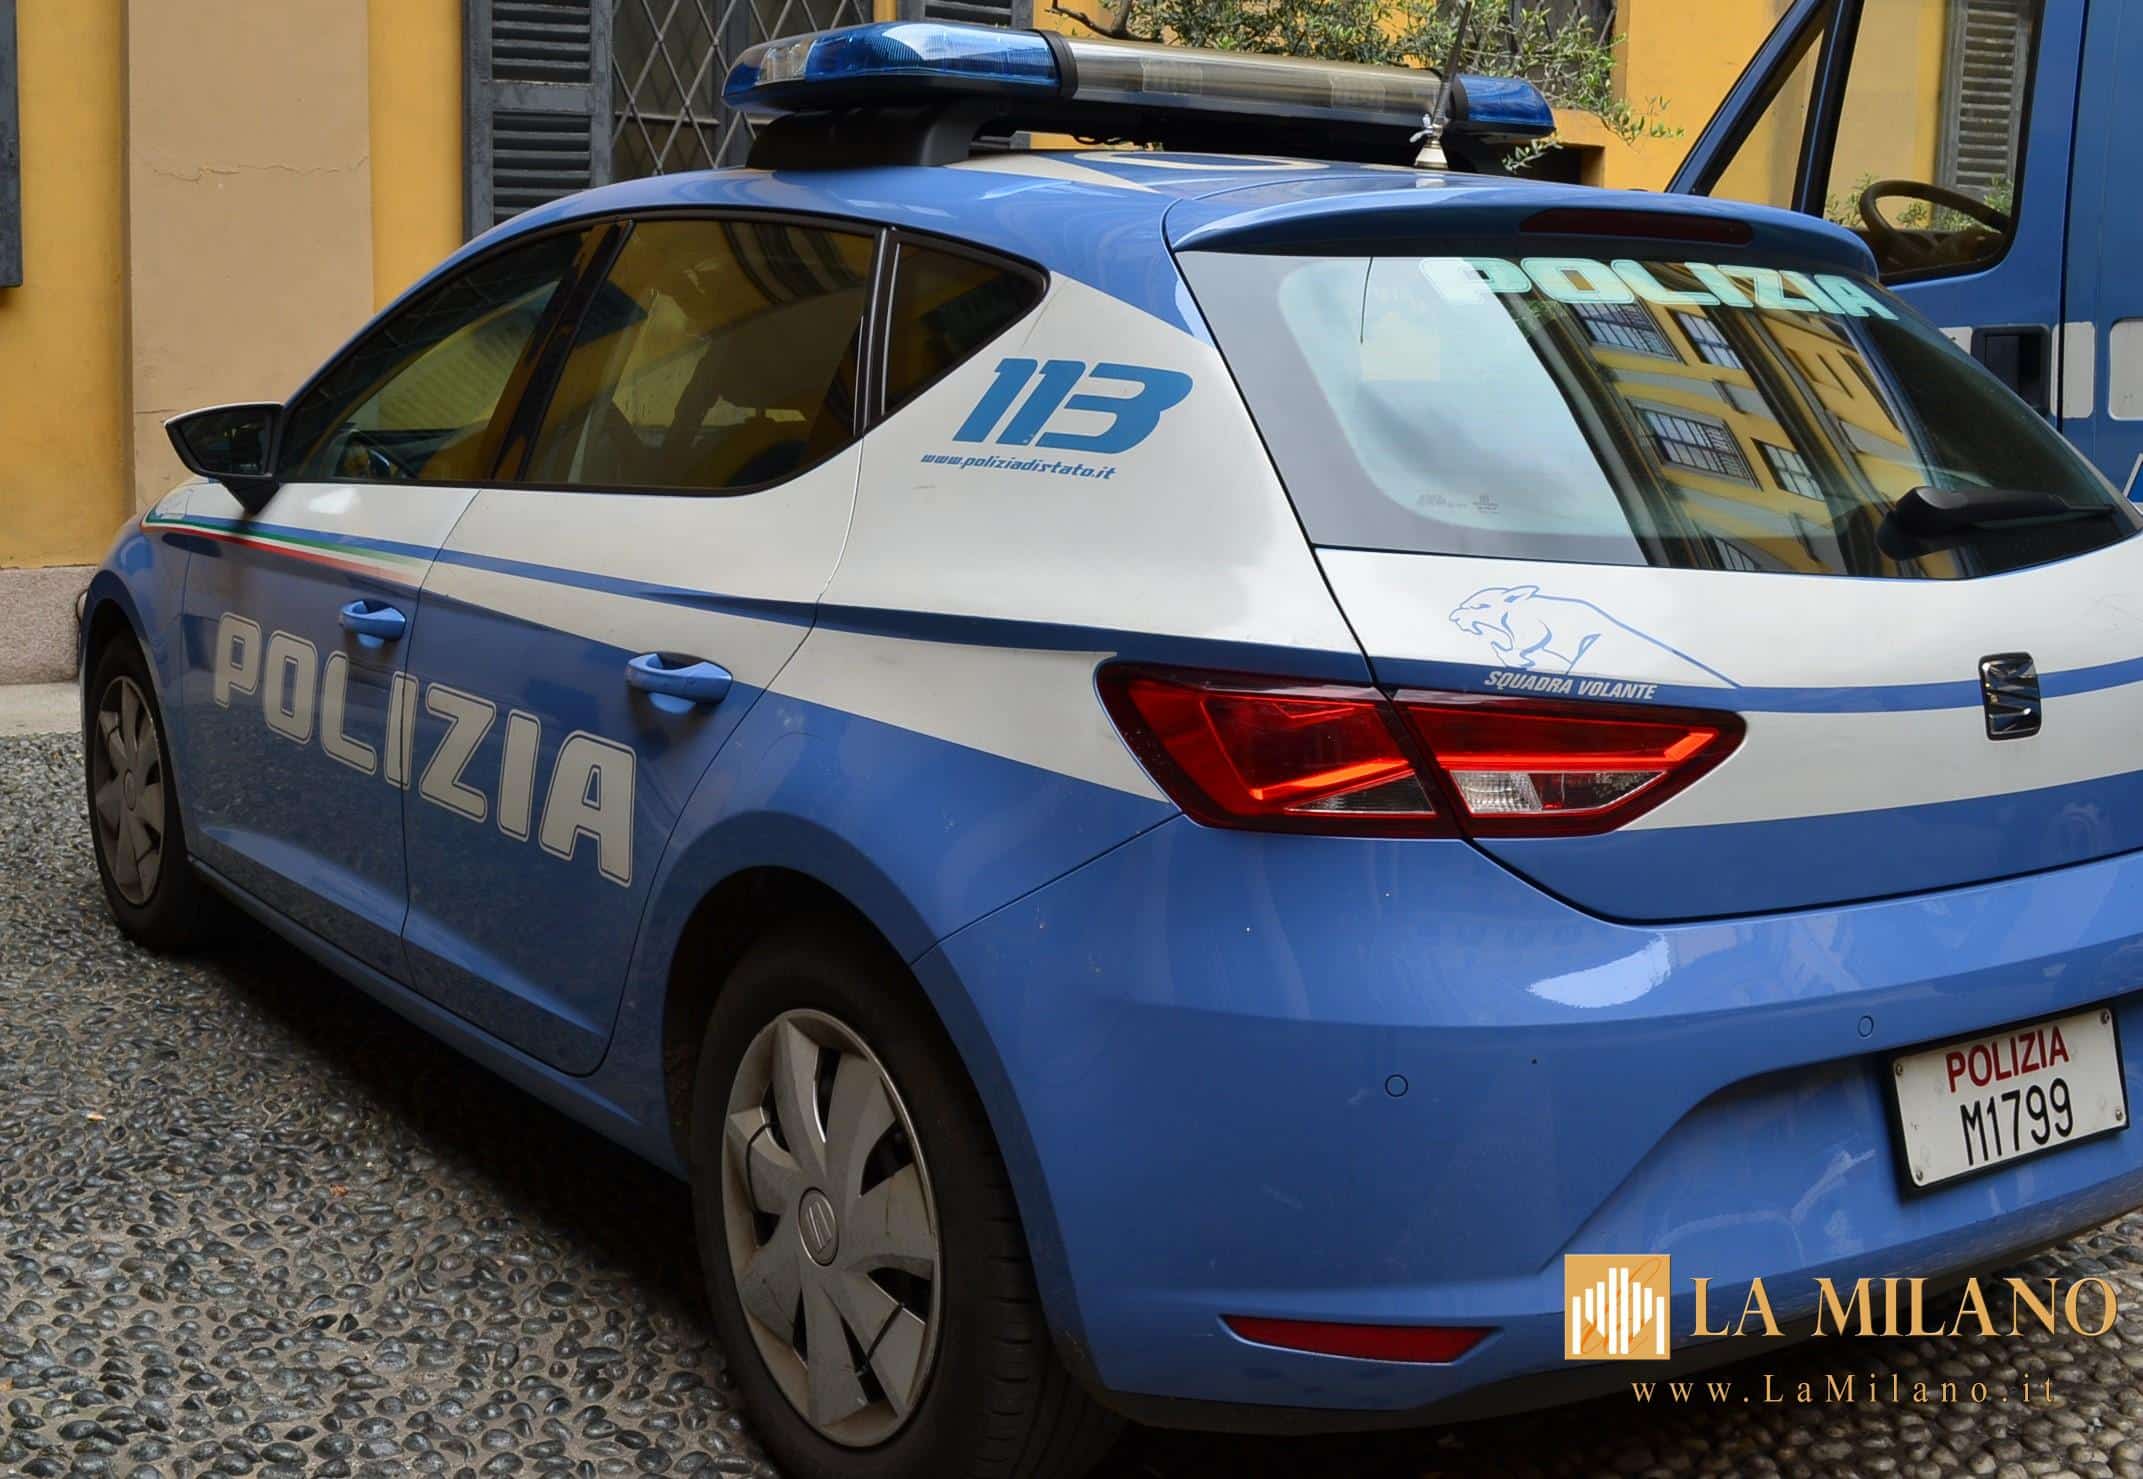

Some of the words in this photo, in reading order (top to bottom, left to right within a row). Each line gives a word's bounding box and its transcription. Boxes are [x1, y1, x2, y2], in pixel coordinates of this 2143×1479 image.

[1419, 257, 1898, 320] POLIZIA
[951, 358, 1193, 453] 113
[920, 452, 1117, 480] www.poliziadistato.it
[1484, 671, 1573, 695] SQUADRA
[1577, 681, 1658, 700] VOLANTE
[212, 611, 637, 888] POLIZIA
[1945, 1025, 2070, 1093] POLIZIA
[1959, 1077, 2074, 1166] M1799
